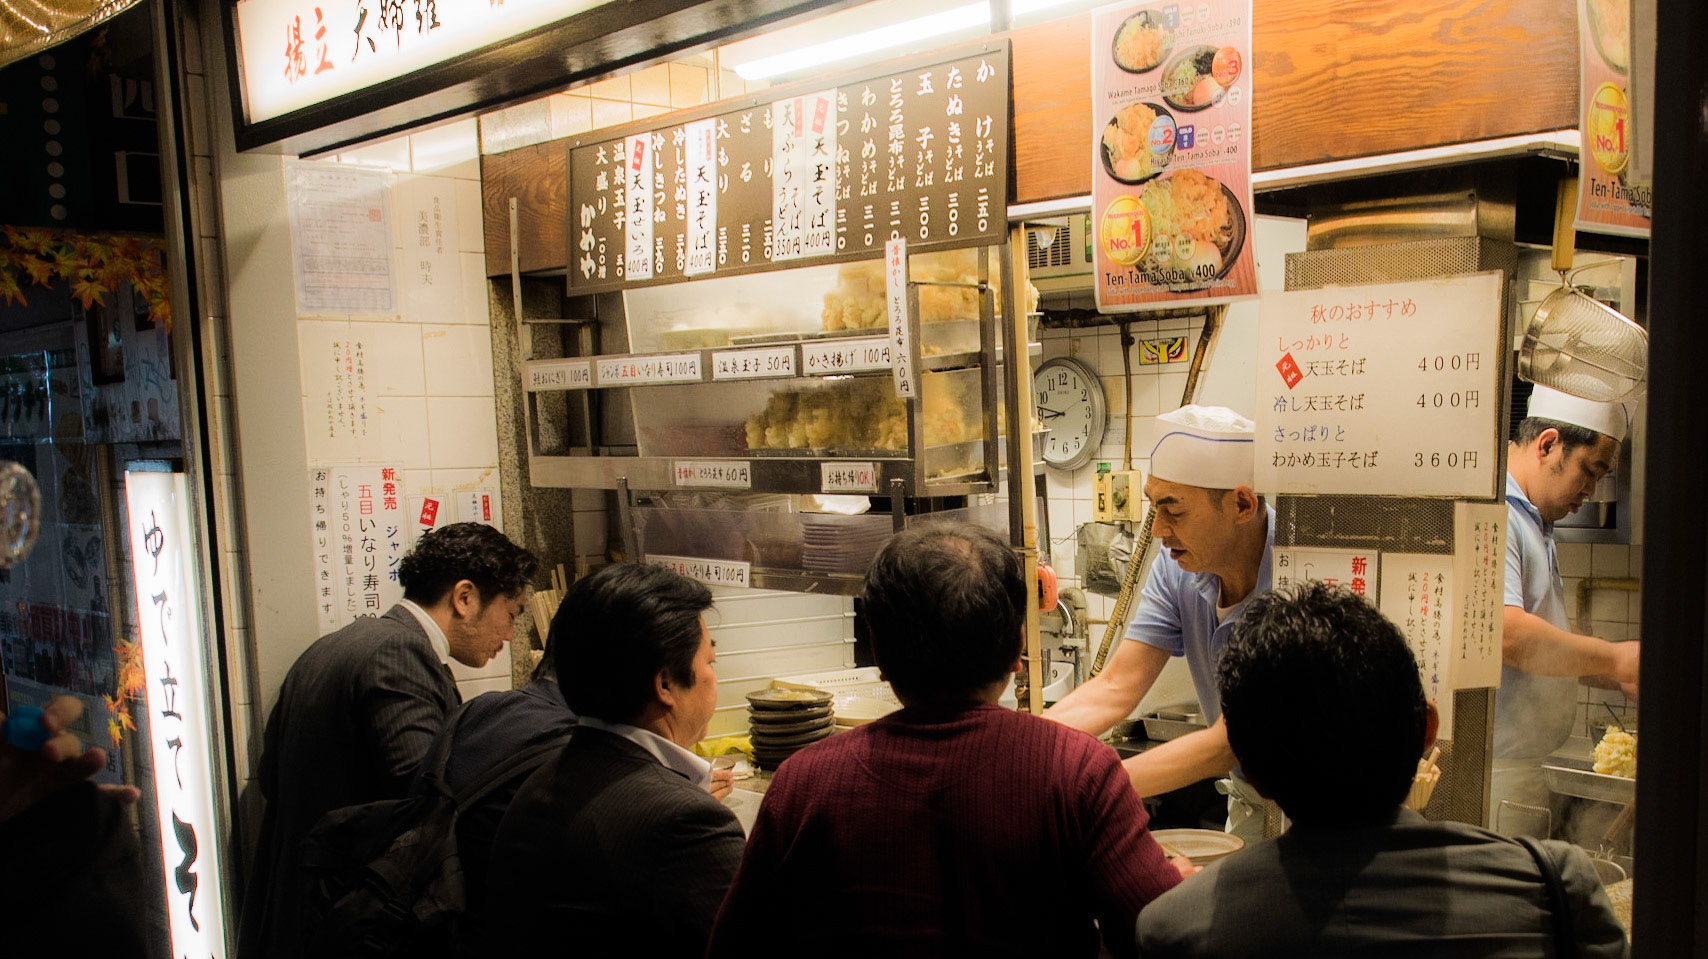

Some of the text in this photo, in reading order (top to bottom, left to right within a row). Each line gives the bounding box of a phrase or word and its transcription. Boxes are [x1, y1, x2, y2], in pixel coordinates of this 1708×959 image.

[946, 66, 963, 143] たぬき
[976, 59, 996, 138] かけ
[1107, 89, 1133, 100] Wakame
[1134, 84, 1157, 97] Tamago
[860, 85, 877, 159] わかめ
[888, 78, 905, 155] とろろ昆布
[915, 71, 934, 150] 玉子
[716, 119, 731, 194] 大もり
[740, 112, 753, 183] ざる
[763, 109, 773, 178] もり
[836, 91, 850, 164] きつね
[843, 165, 851, 199] そば
[974, 140, 984, 178] うどん
[984, 138, 995, 177] そば
[651, 133, 666, 223] 冷しきつね
[672, 127, 686, 220] 冷したぬき
[776, 103, 802, 237] 天ぷら そば うどん
[860, 161, 868, 196] うどん
[868, 160, 877, 194] そば
[887, 156, 896, 192] うどん
[896, 155, 905, 190] そば
[915, 151, 924, 188] うどん
[924, 150, 934, 186] そば
[944, 146, 954, 183] うどん
[954, 144, 964, 181] そば
[596, 146, 609, 215] 大盛り
[612, 141, 626, 230] 温泉玉子
[811, 136, 829, 229] 天玉そば
[1636, 186, 1652, 204] Sob
[631, 173, 646, 255] 天玉せいろ
[694, 164, 710, 250] 天玉そば
[579, 203, 597, 280] かめや
[776, 236, 801, 256] 350円
[805, 231, 831, 248] 400円
[1159, 264, 1186, 281] Soba
[1310, 298, 1417, 324] 秋のおすすめ
[809, 346, 891, 369] かき揚げ 100円
[1277, 332, 1350, 352] しっかりと
[569, 367, 589, 383] 100円
[717, 354, 791, 373] 温泉玉子 50円
[1058, 372, 1068, 386] 12
[1304, 352, 1481, 377] 天玉そば 400円
[1039, 390, 1048, 405] 10
[1047, 378, 1055, 391] 11
[1073, 376, 1077, 390] 1
[1081, 388, 1087, 402] 2
[1085, 405, 1091, 420] 3
[1273, 389, 1480, 413] 冷し天玉そば 400円
[1050, 437, 1056, 451] 7
[1074, 436, 1080, 450] 5
[1082, 423, 1088, 437] 4
[1274, 425, 1346, 442] さっぱりと
[1062, 441, 1069, 455] 6
[1272, 450, 1478, 469] わかめ玉子そば 360円
[381, 467, 398, 510] 新発売
[725, 467, 748, 482] 60円
[358, 484, 381, 610] 五目いなり寿司
